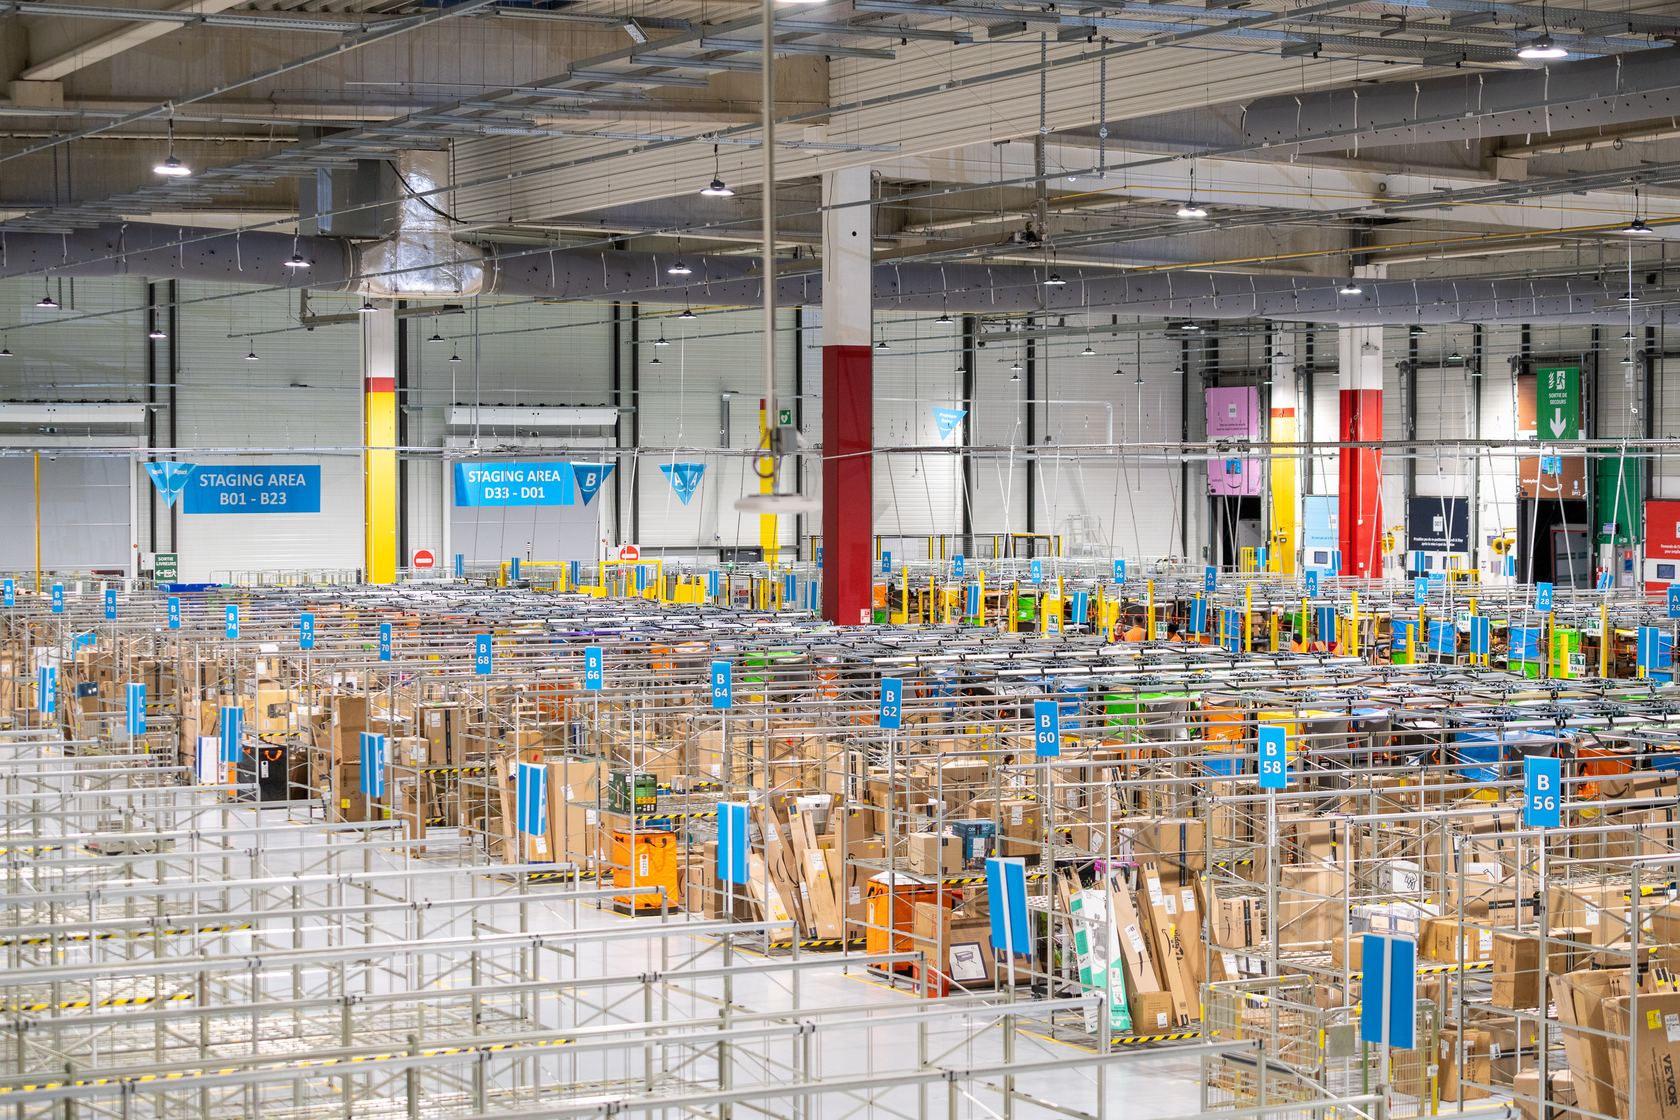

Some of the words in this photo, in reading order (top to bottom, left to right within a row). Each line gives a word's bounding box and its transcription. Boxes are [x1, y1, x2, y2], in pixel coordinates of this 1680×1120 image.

[199, 473, 264, 487] STAGING
[267, 473, 306, 487] AREA
[468, 470, 524, 483] STAGING
[527, 470, 561, 482] AREA
[585, 473, 597, 487] B
[674, 472, 684, 486] A
[690, 472, 697, 485] A
[220, 492, 247, 505] B01
[260, 492, 287, 505] B23
[484, 487, 509, 499] D33
[521, 486, 545, 499] D01
[1418, 583, 1424, 591] A
[1542, 589, 1548, 597] A
[107, 596, 113, 604] B
[1672, 595, 1679, 603] A
[228, 613, 235, 621] B
[303, 621, 310, 630] B
[302, 632, 311, 640] 72
[382, 632, 388, 641] B
[382, 643, 390, 652] 70
[480, 643, 487, 653] B
[478, 656, 489, 664] 68
[589, 657, 596, 667] B
[587, 670, 600, 679] 66
[716, 673, 725, 685] B
[714, 687, 728, 698] 64
[886, 690, 895, 702] B
[882, 706, 897, 717] 62
[1041, 714, 1051, 728] B
[1038, 732, 1055, 744] 60
[1266, 741, 1277, 757] B
[1263, 761, 1282, 774] 58
[1537, 774, 1550, 791] B
[1533, 796, 1555, 811] 56
[1663, 1053, 1678, 1106] VEVOR
